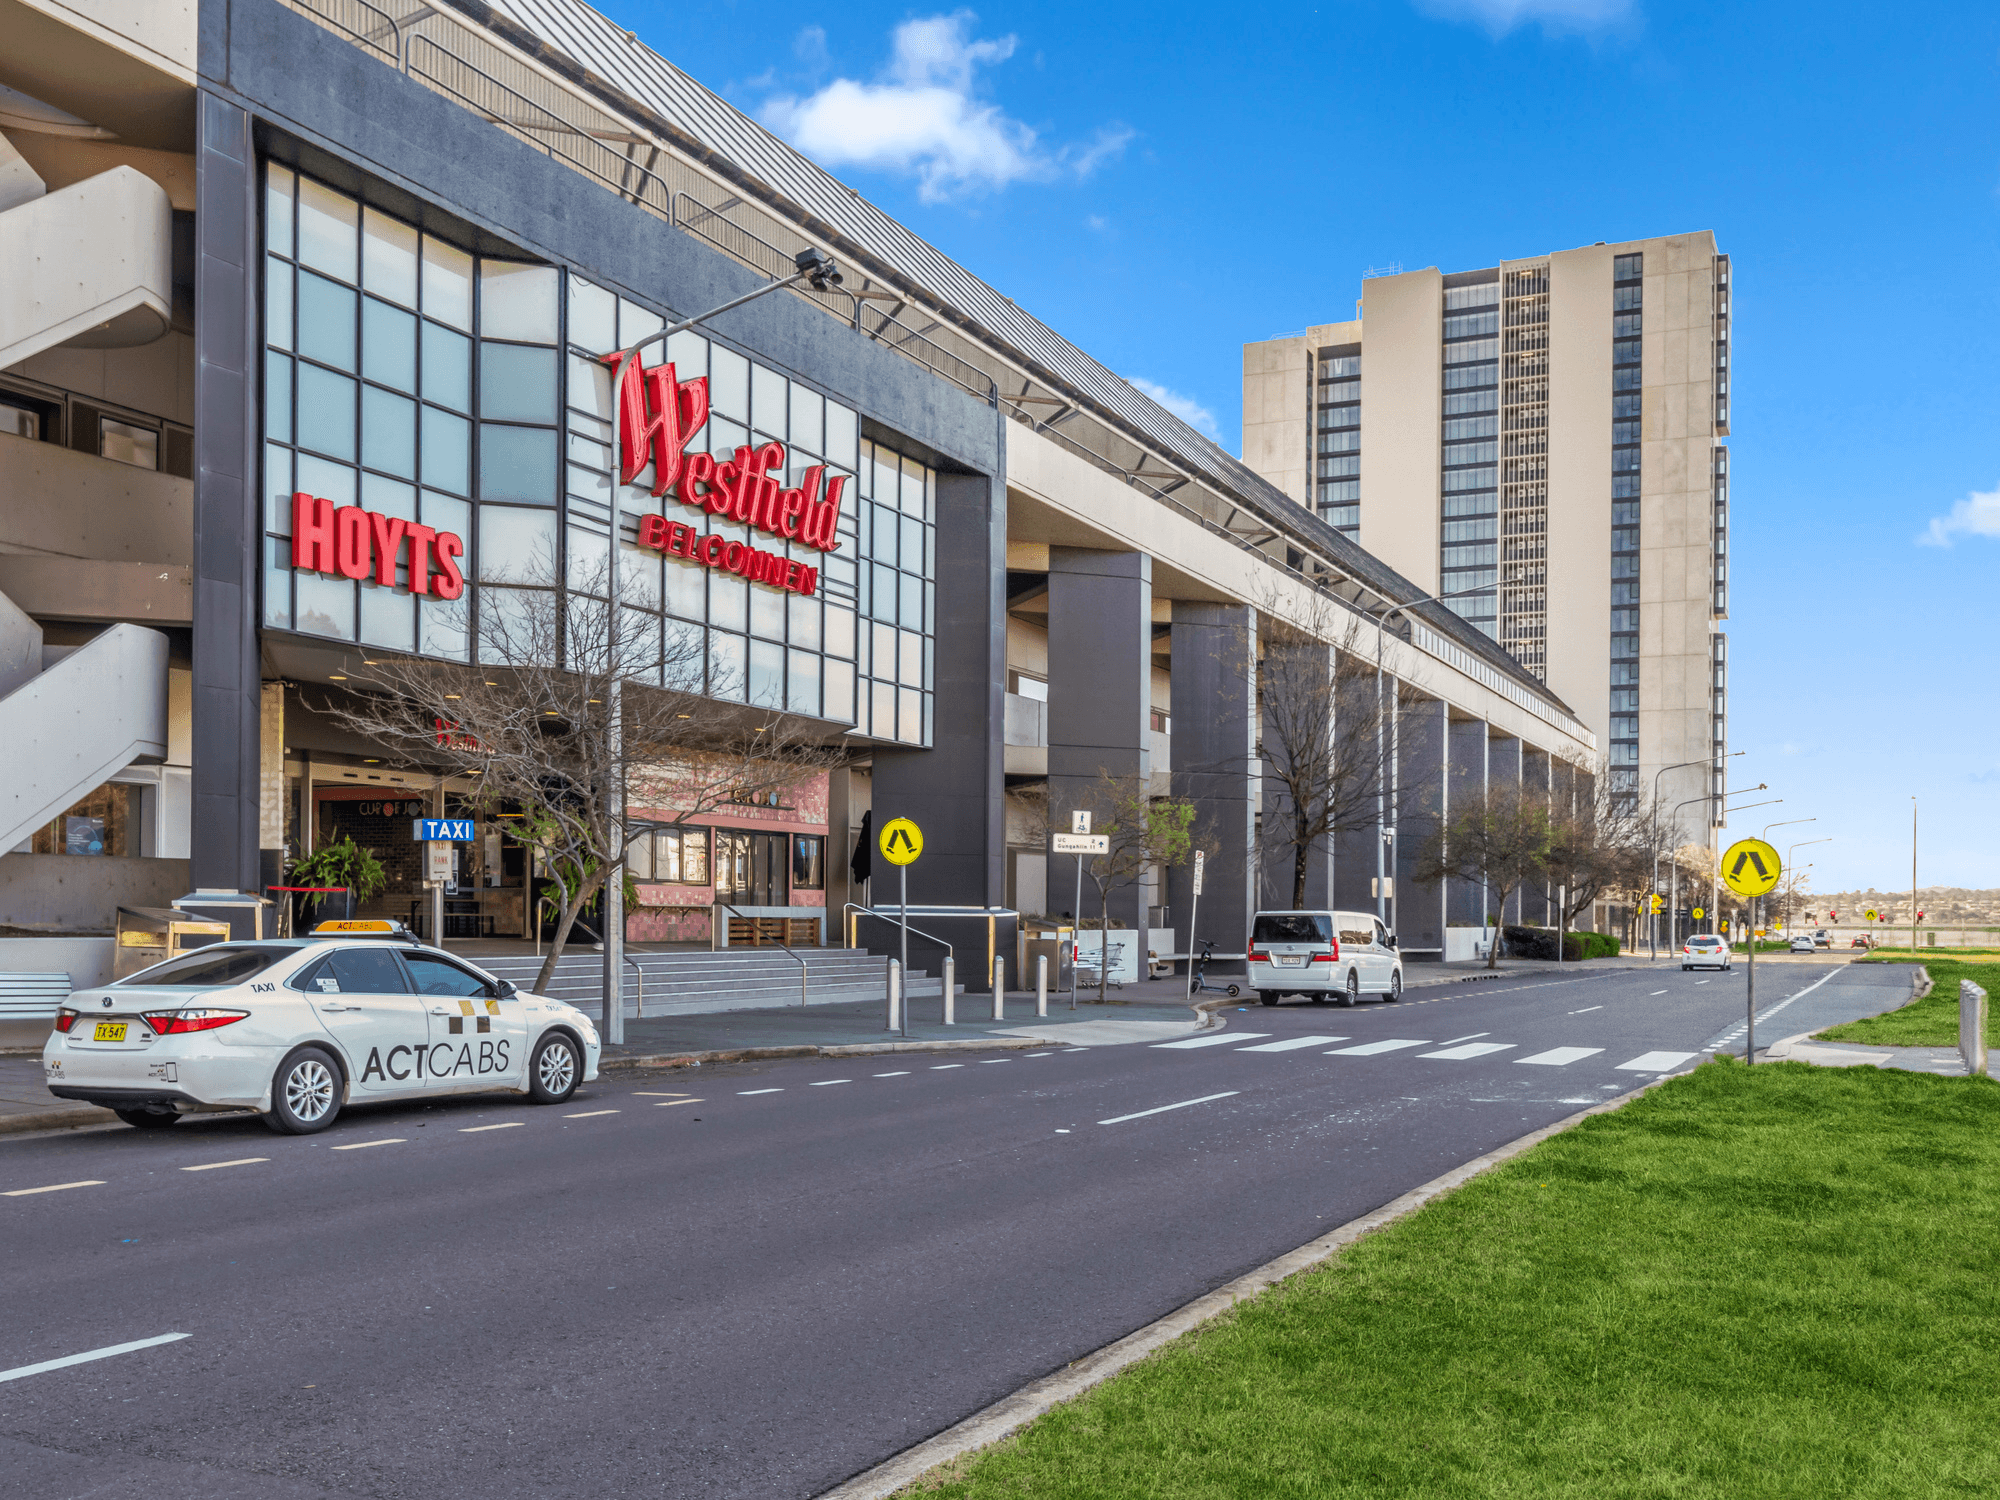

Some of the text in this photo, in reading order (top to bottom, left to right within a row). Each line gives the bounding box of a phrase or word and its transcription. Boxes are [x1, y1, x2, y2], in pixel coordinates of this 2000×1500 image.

[600, 347, 852, 552] Westfield
[292, 492, 463, 600] HOYTS
[638, 514, 818, 596] BELCONNEN
[358, 801, 382, 816] CUP
[427, 821, 470, 839] TAXI
[250, 982, 276, 993] TAXI
[360, 1039, 510, 1083] ACTCABS
